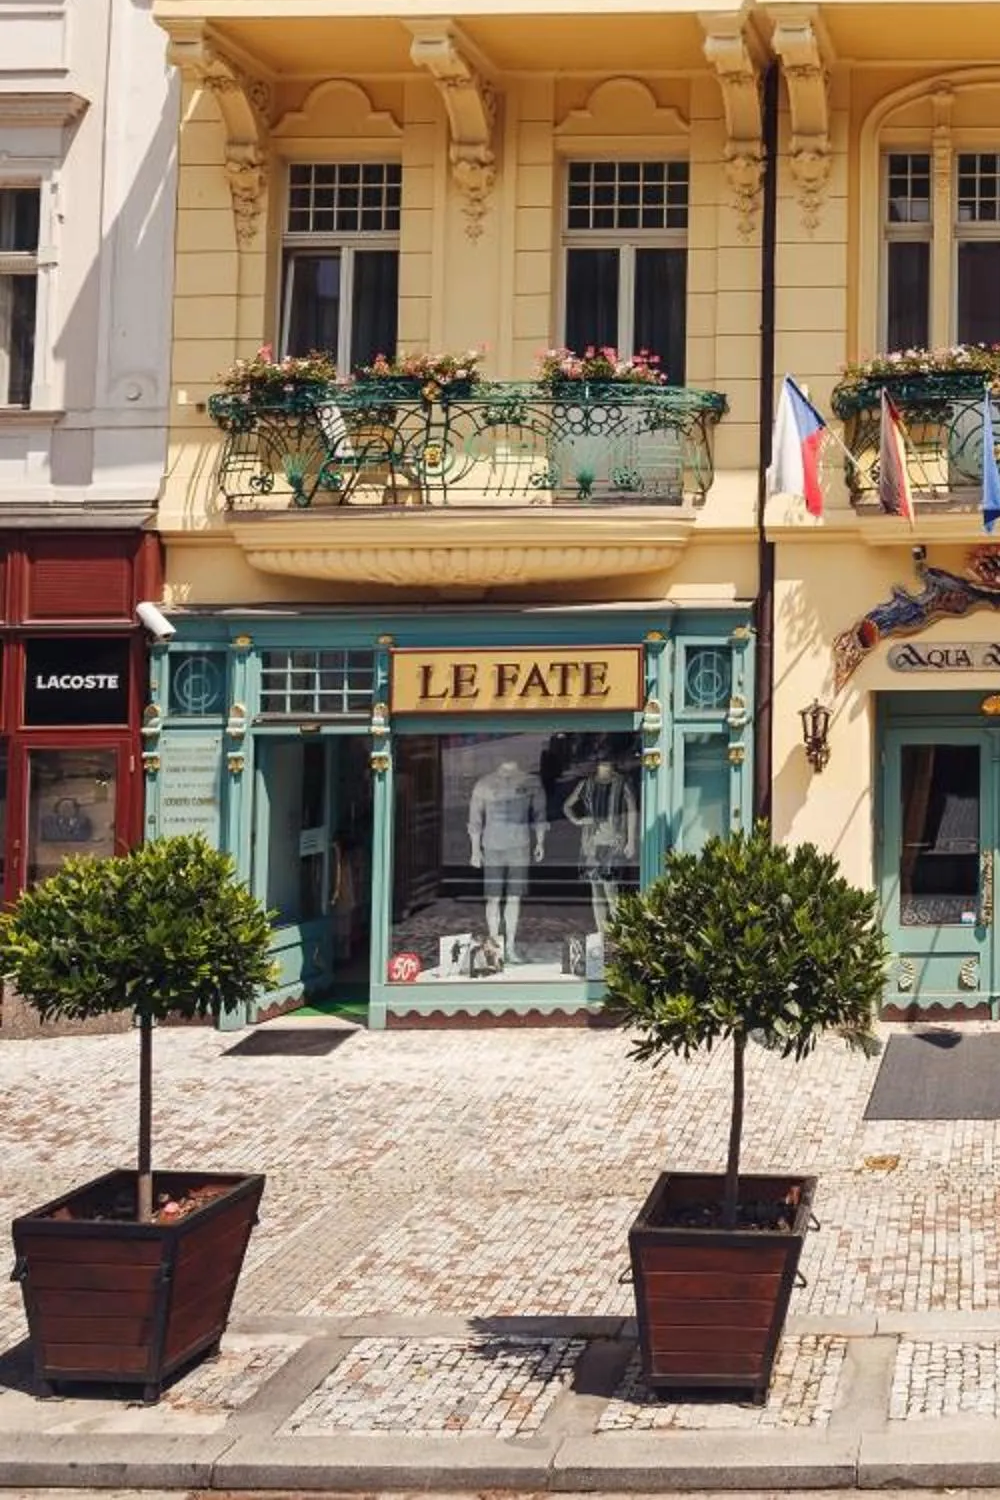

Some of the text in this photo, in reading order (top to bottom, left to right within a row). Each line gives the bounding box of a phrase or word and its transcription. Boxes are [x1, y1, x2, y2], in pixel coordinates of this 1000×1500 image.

[896, 643, 972, 667] AQUA
[36, 674, 120, 690] LACOSTE
[419, 661, 611, 699] LE FATE
